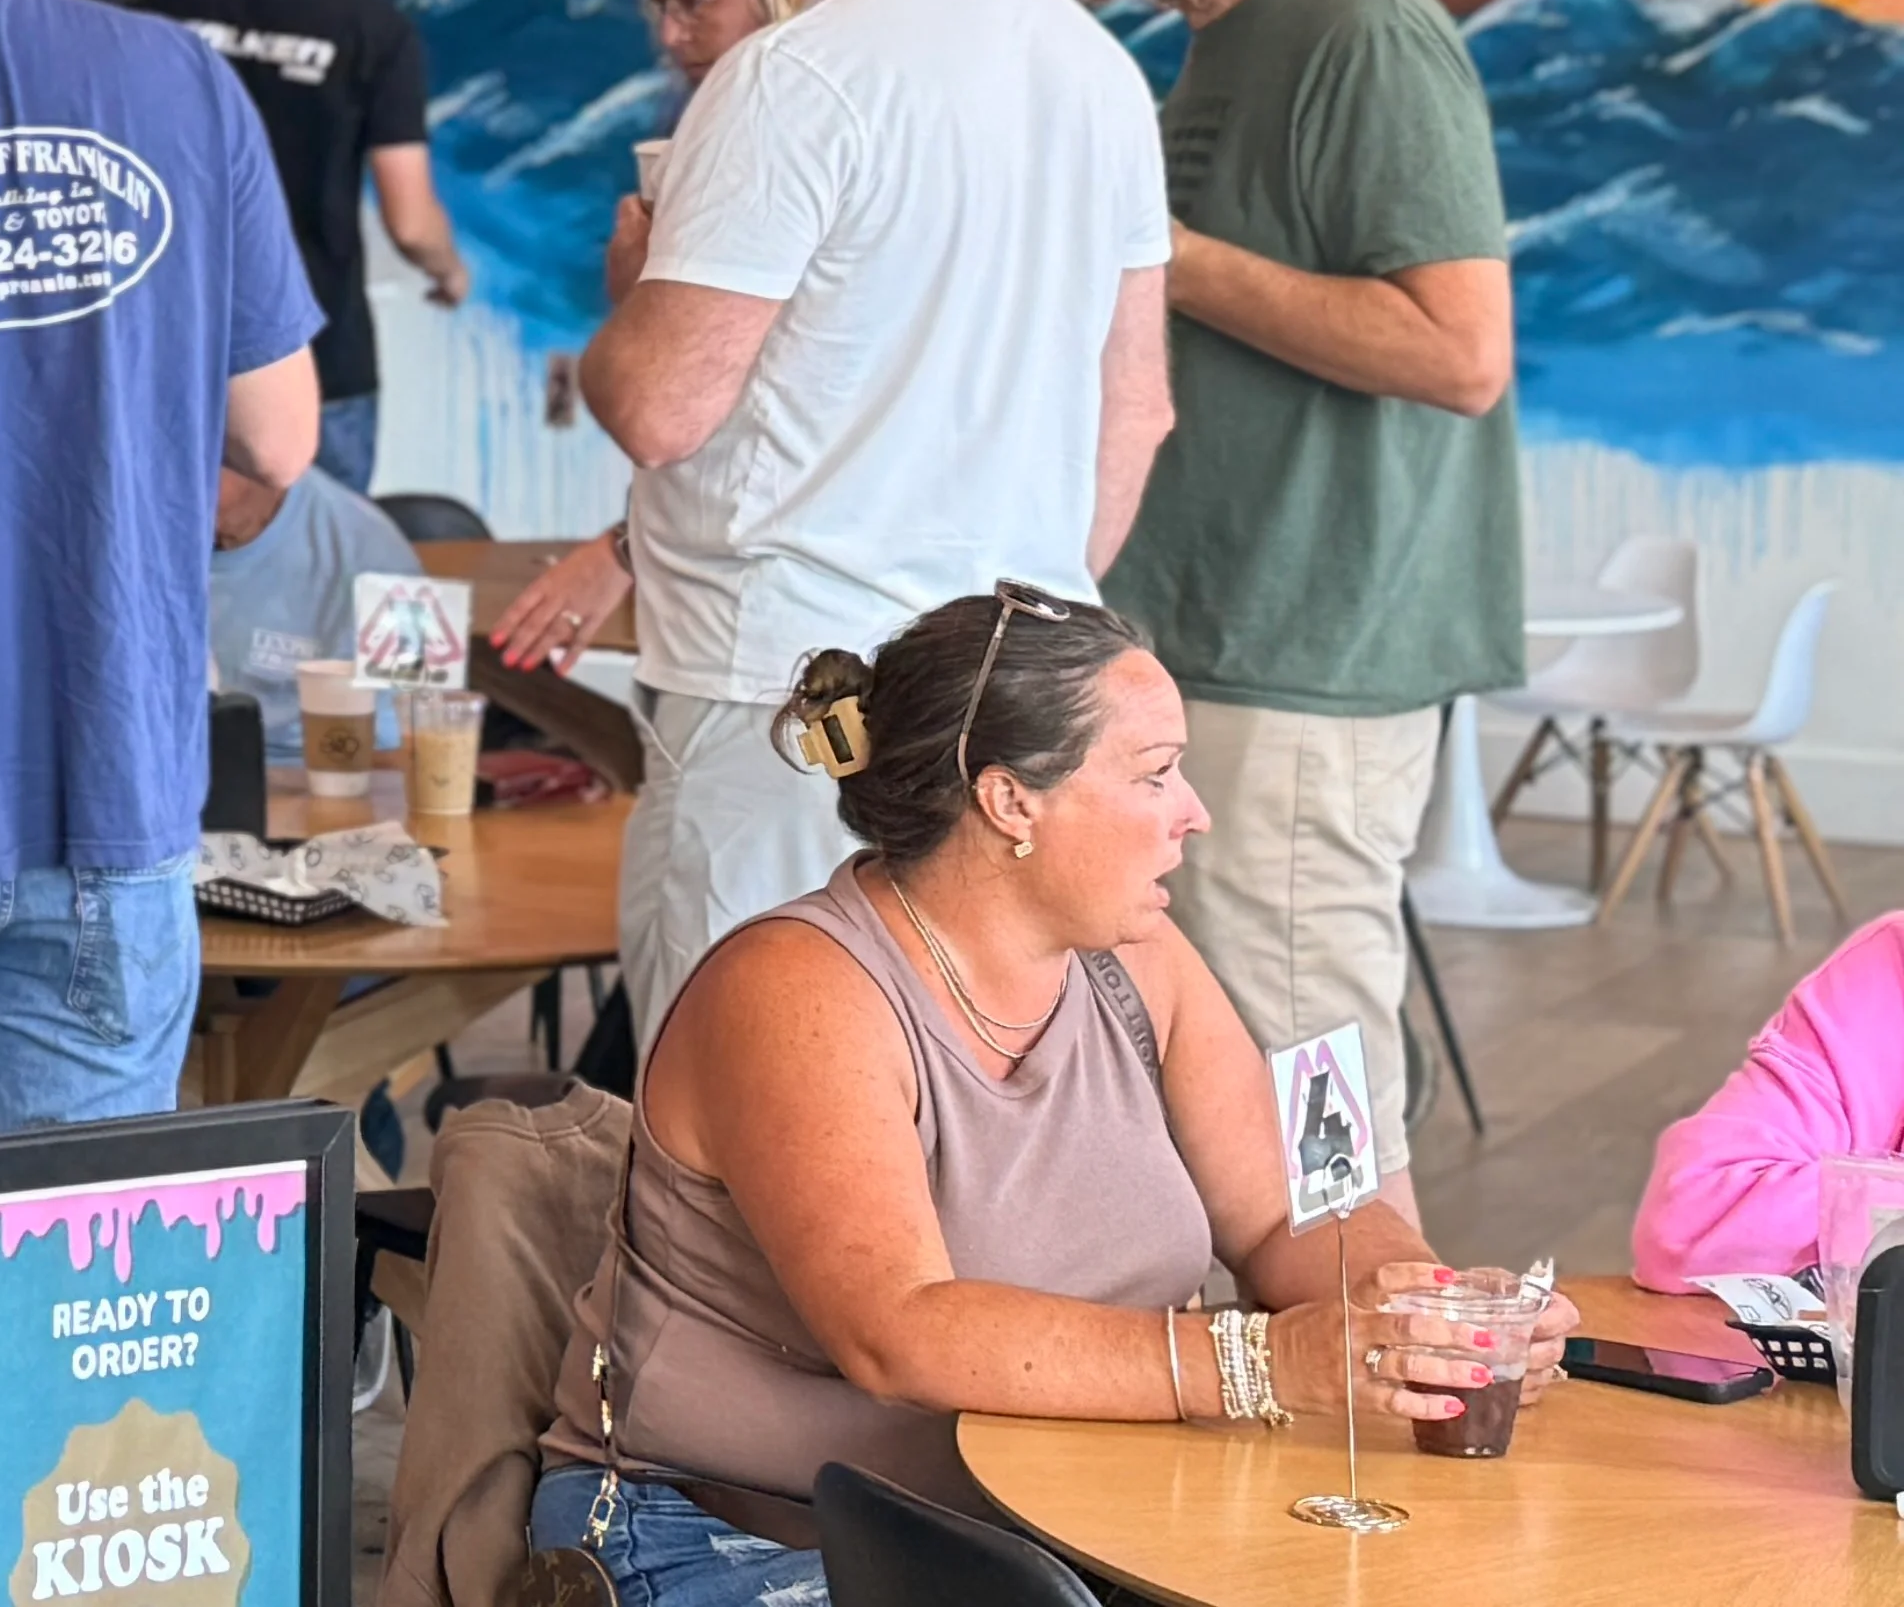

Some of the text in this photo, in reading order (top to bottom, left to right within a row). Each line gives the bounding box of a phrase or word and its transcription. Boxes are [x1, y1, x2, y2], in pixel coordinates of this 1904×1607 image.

[16, 140, 151, 219] FRANKLIN
[70, 181, 94, 198] in
[4, 211, 25, 232] &
[52, 1286, 210, 1339] READY TO
[72, 1332, 199, 1379] ORDER?
[56, 1467, 209, 1526] Use the
[32, 1517, 230, 1600] KIOSK
